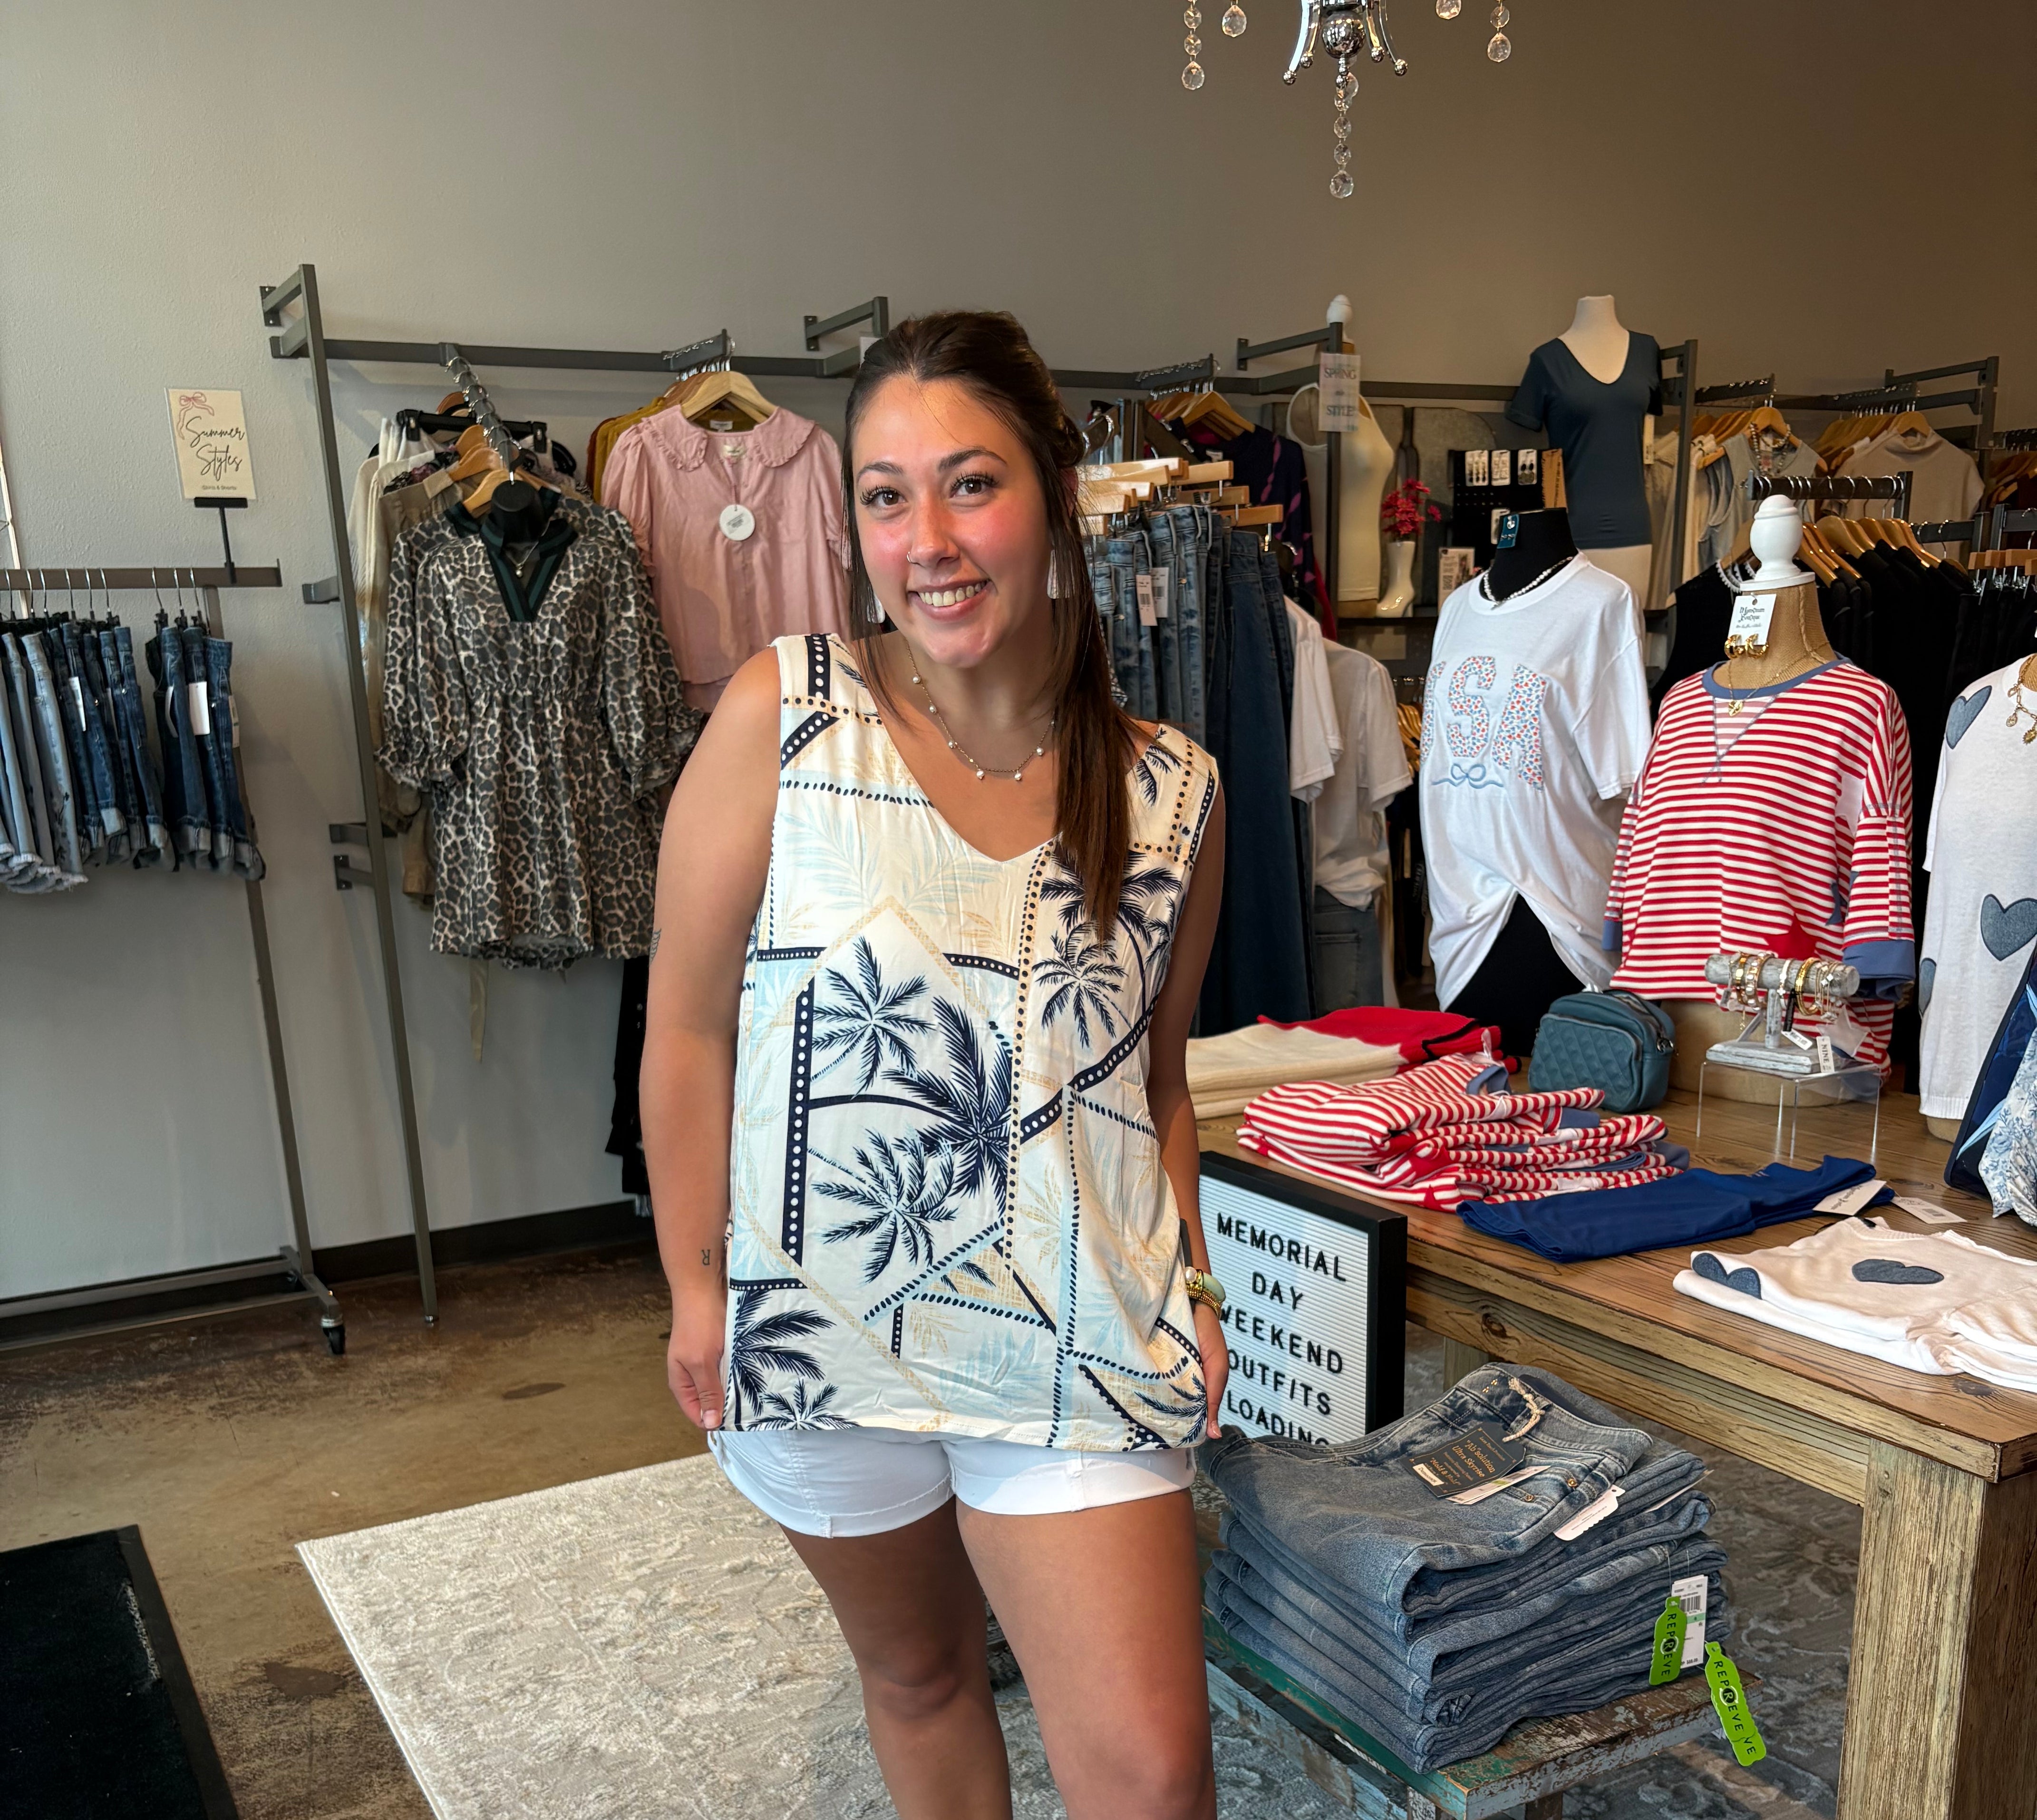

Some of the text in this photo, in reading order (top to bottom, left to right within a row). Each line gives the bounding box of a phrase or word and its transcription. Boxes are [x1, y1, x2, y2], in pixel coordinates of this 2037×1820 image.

[1324, 369, 1356, 380] SPRING
[186, 416, 245, 448] Summer
[196, 444, 242, 482] Styles
[701, 1249, 710, 1265] R
[1217, 1212, 1346, 1282] MEMORIAL
[1252, 1271, 1303, 1310] DAY
[1228, 1349, 1330, 1415] OUTFITS
[1452, 1445, 1485, 1478] Ultra Skyrise
[1661, 1613, 1677, 1677] REPREVE
[1714, 1660, 1744, 1732] REPREVE
